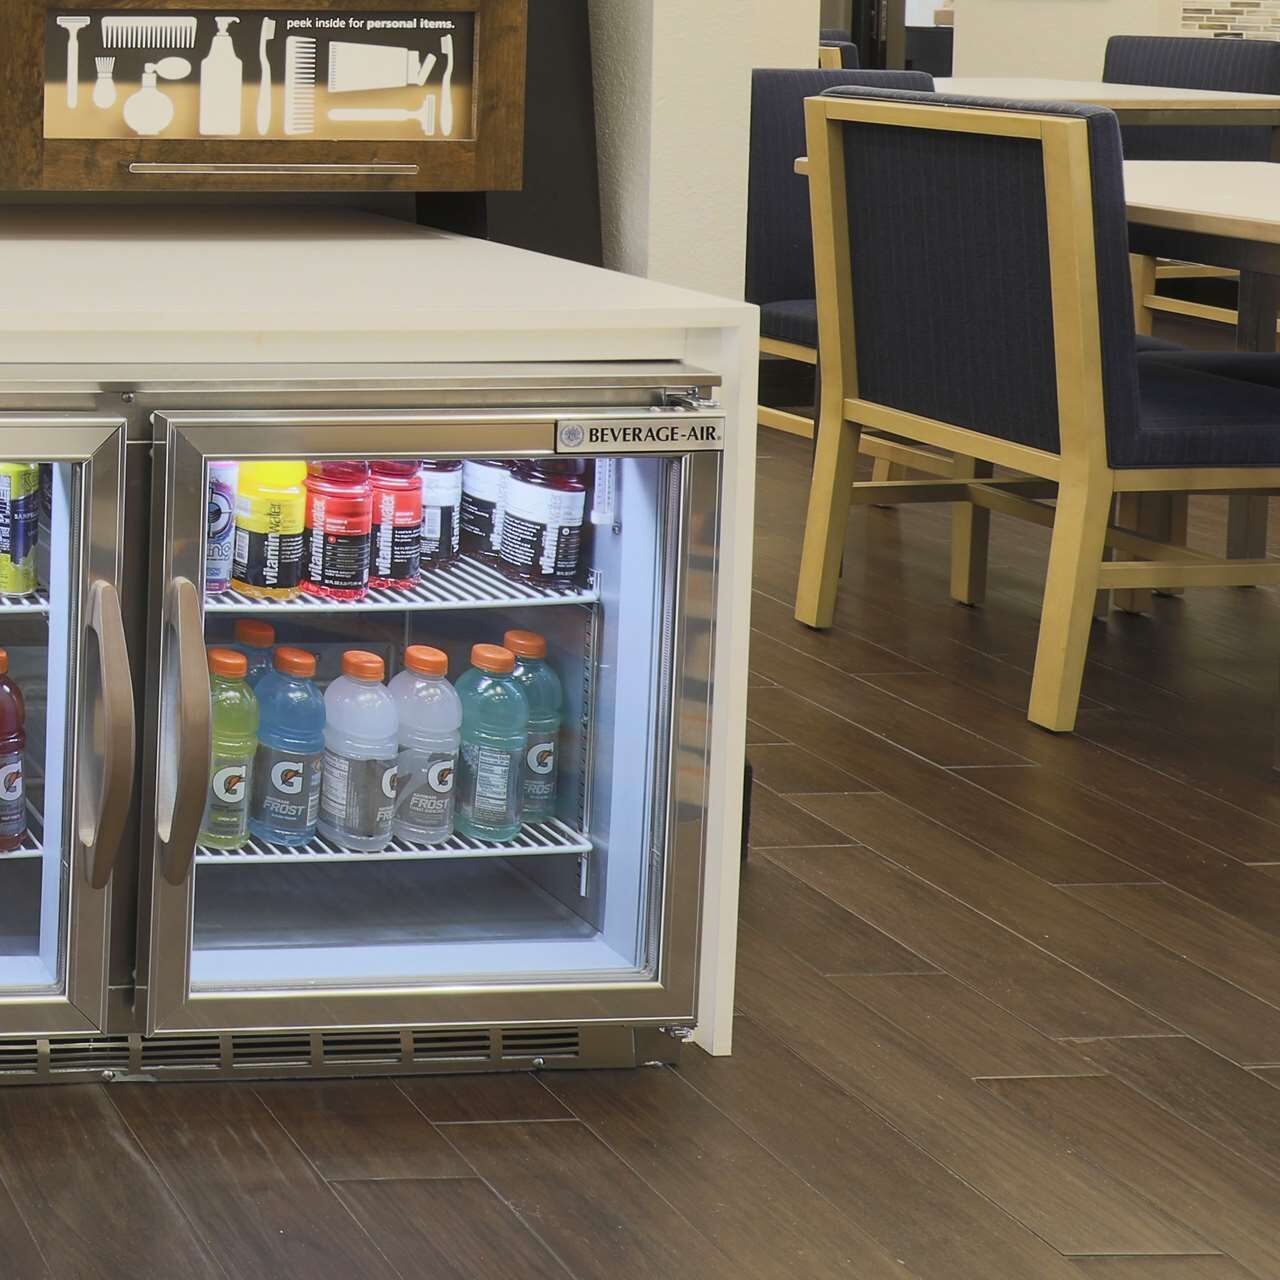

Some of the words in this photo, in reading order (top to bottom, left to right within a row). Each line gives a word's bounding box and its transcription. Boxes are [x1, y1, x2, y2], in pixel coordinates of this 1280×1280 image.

[286, 17, 313, 30] peek
[315, 17, 346, 28] inside
[348, 17, 365, 29] for
[366, 18, 418, 30] personal
[419, 18, 456, 29] items.
[589, 425, 717, 443] BEVERAGE-AIR
[526, 741, 555, 775] G
[213, 766, 246, 803] G
[271, 761, 305, 795] G
[427, 758, 455, 794] G
[263, 800, 307, 817] FROST
[410, 797, 450, 811] FROST
